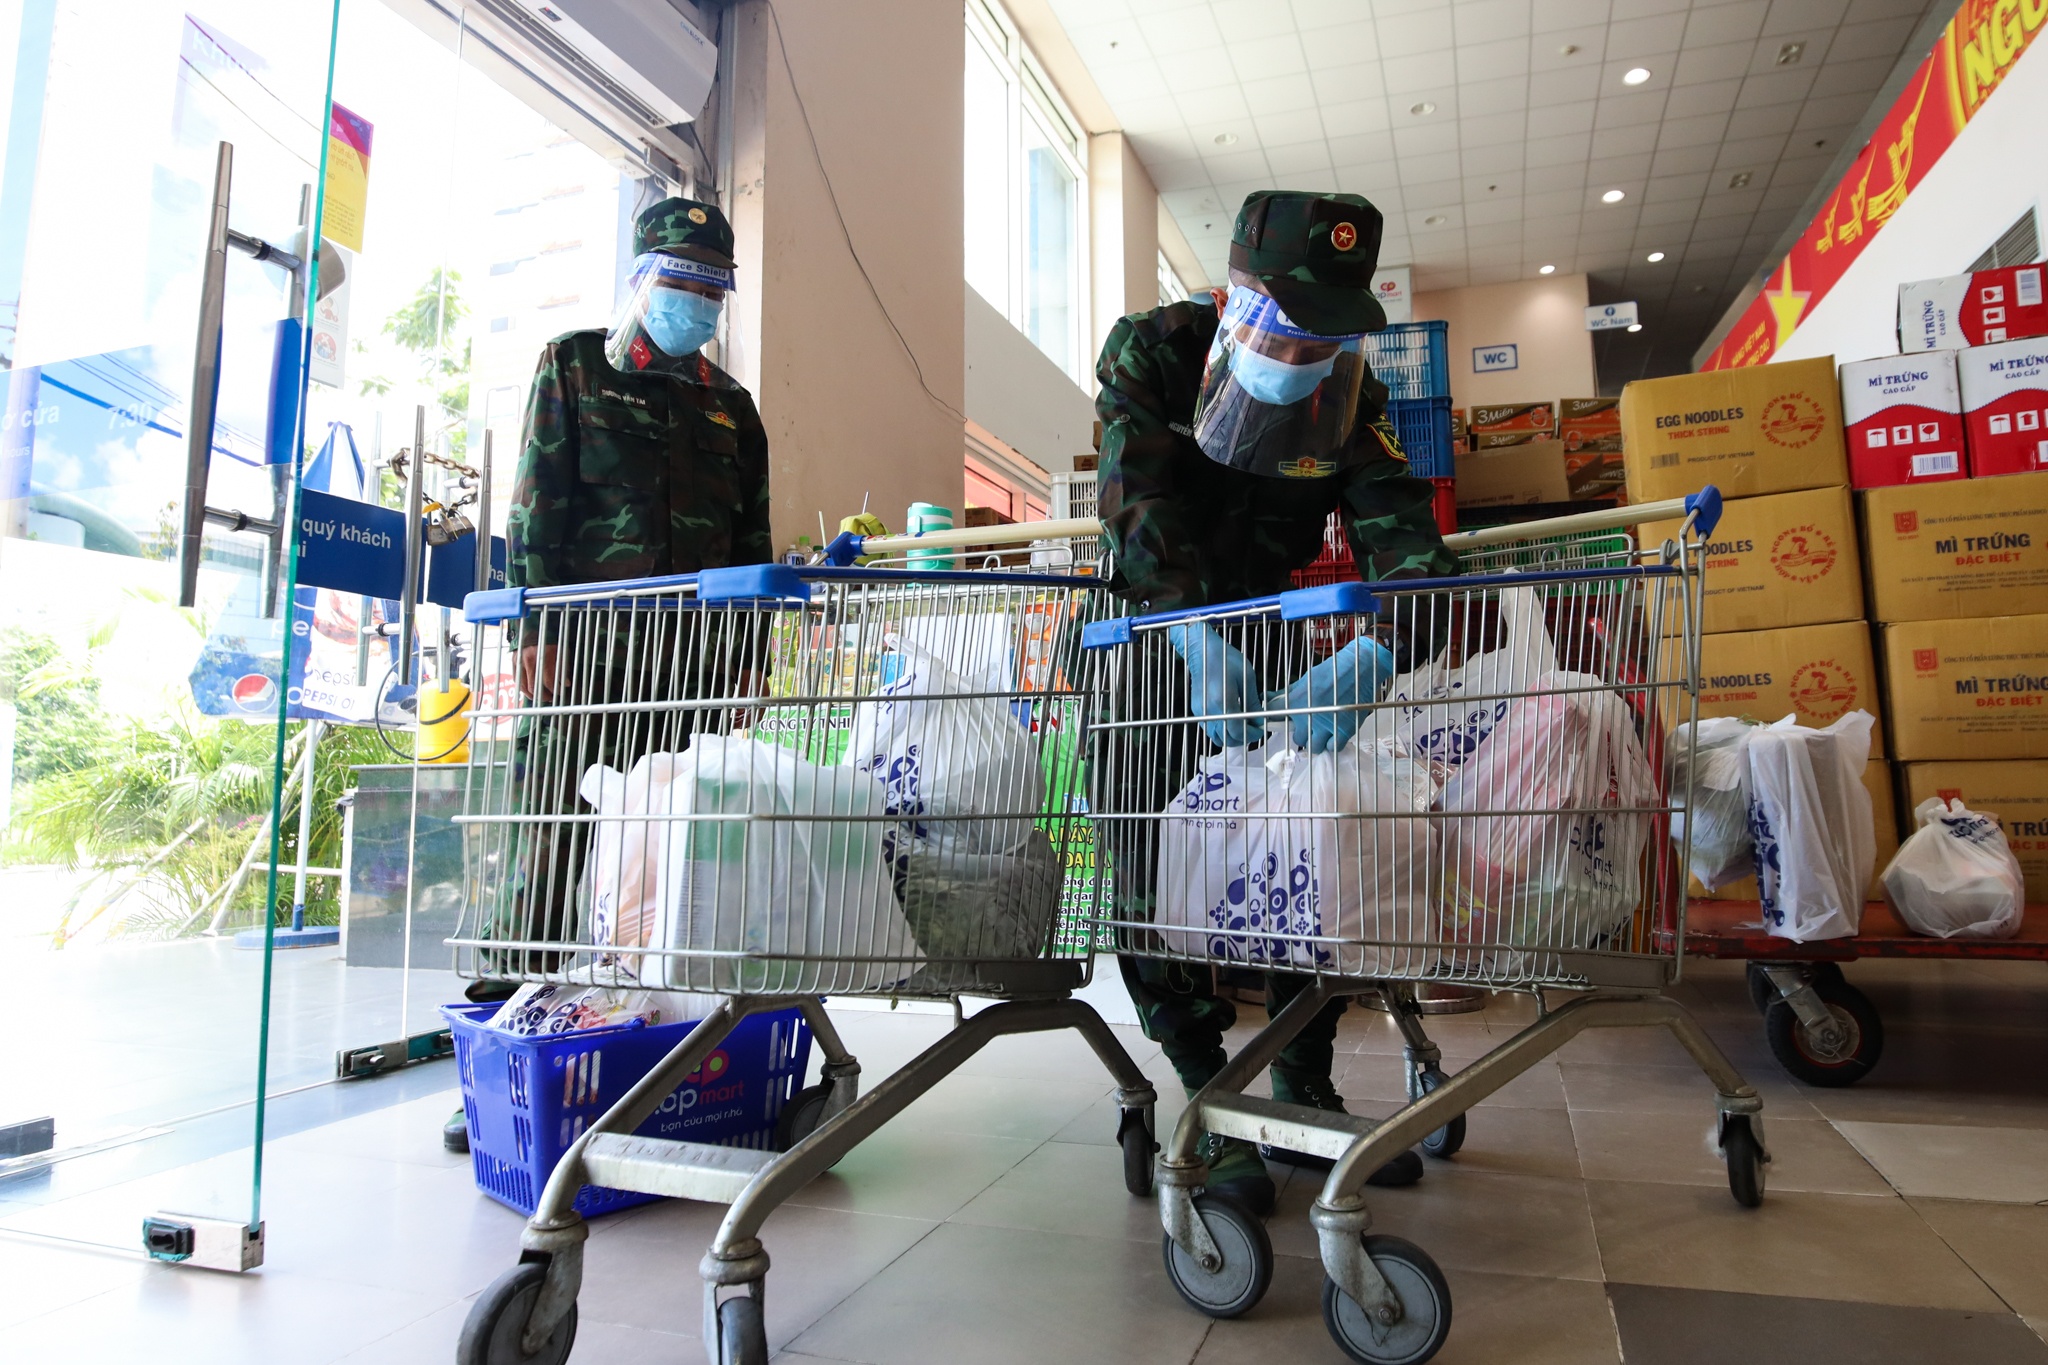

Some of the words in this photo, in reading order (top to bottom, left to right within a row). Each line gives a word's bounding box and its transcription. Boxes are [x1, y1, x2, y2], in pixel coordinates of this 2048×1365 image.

[667, 259, 692, 270] Face
[696, 263, 726, 278] Shield
[1592, 318, 1607, 327] WC
[1610, 317, 1633, 325] Nam
[1484, 352, 1507, 364] WC
[1990, 359, 2005, 372] MÌ
[1868, 375, 1883, 387] MÌ
[1885, 370, 1929, 385] TRỨNG
[2005, 372, 2022, 380] CAO
[21, 400, 60, 428] cửa
[108, 402, 152, 430] 7:30
[1656, 414, 1681, 429] EGG
[1684, 407, 1744, 426] NOODLES
[1668, 426, 1695, 440] THICK
[1697, 425, 1730, 437] STRING
[1688, 455, 1717, 463] PRODUCT
[1728, 451, 1755, 460] VIETNAM
[302, 518, 336, 542] quý
[340, 521, 391, 550] khách
[1936, 536, 1959, 554] MÌ
[1964, 532, 2031, 551] TRỨNG
[1706, 558, 1739, 570] STRING
[1989, 552, 2022, 565] BIỆT
[1728, 586, 1736, 594] OF
[1737, 584, 1765, 593] VIETNAM
[1682, 678, 1707, 691] EG
[1711, 672, 1772, 689] NOODLES
[1956, 674, 1979, 695] MÌ
[304, 688, 338, 706] PEPSI
[1699, 694, 1721, 704] HICK
[1724, 692, 1758, 702] STRING
[2010, 695, 2044, 707] BIỆT
[661, 1121, 682, 1133] bạn
[684, 1116, 703, 1127] của
[705, 1112, 722, 1123] mọi
[724, 1106, 743, 1119] nhà
